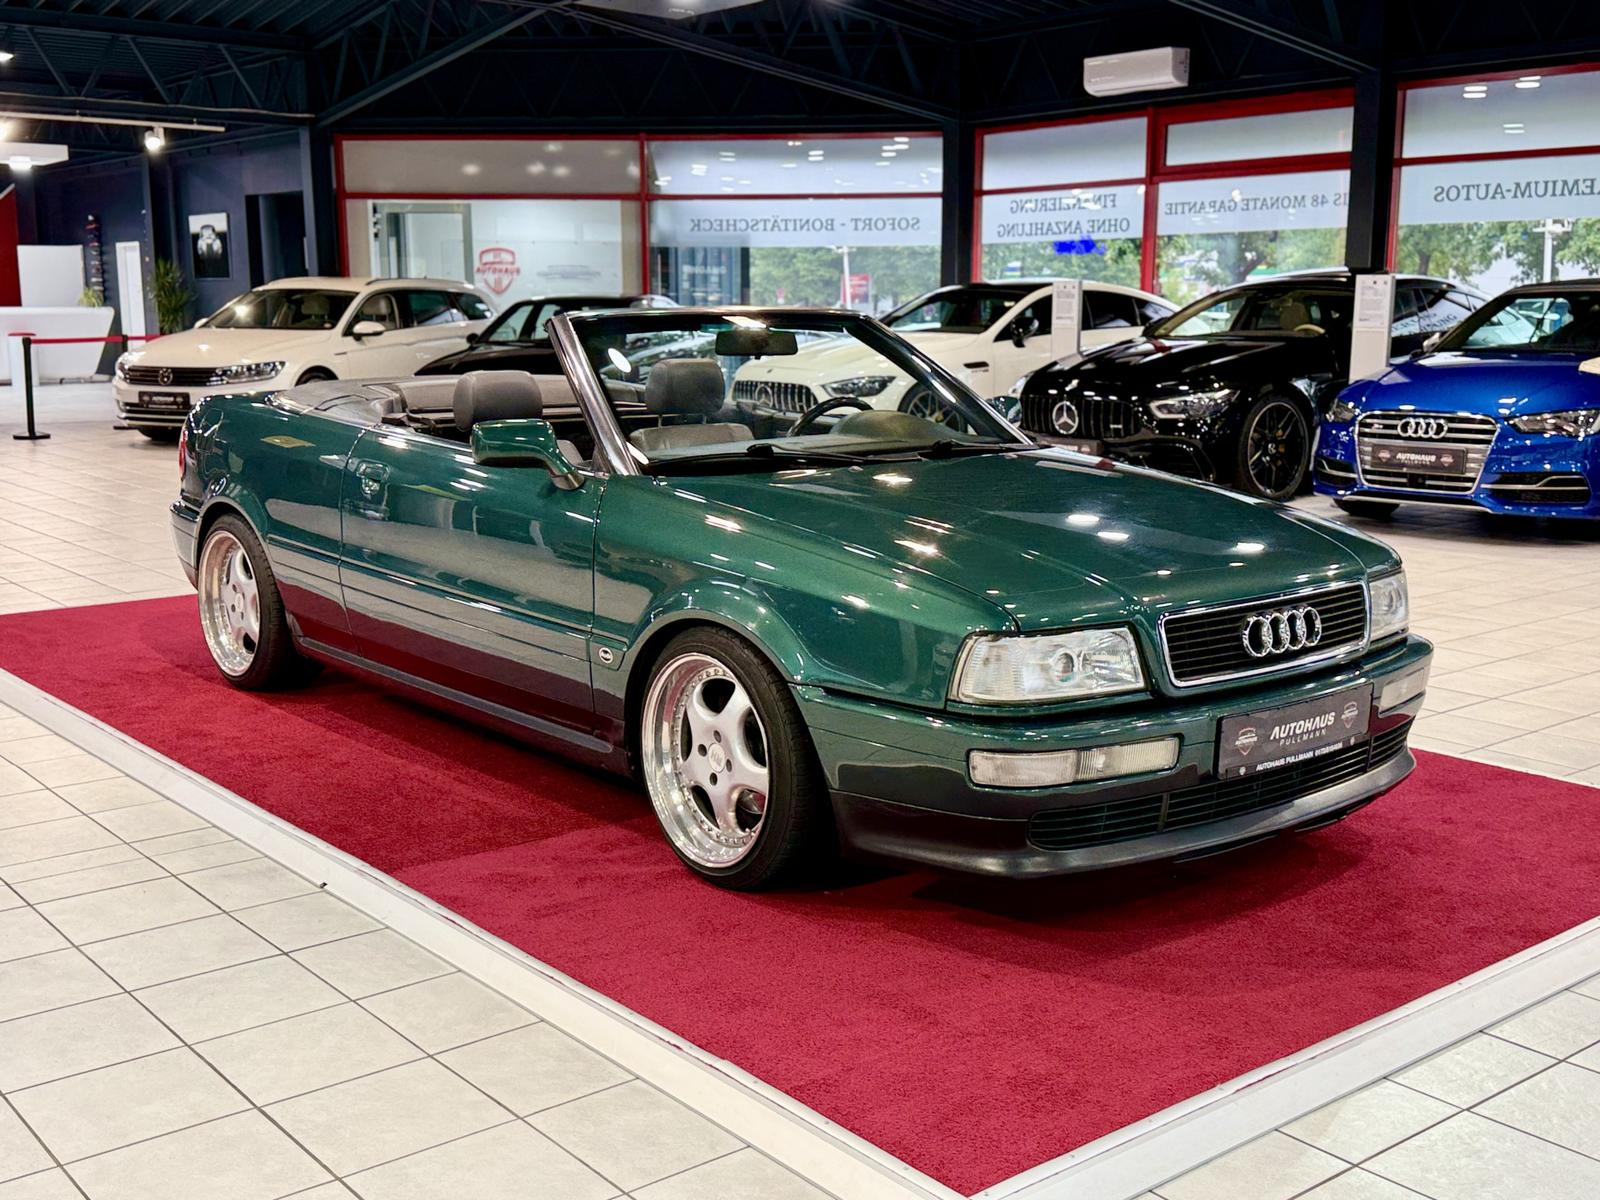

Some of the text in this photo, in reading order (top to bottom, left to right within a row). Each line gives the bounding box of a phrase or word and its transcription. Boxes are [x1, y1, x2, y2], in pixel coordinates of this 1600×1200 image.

[474, 267, 521, 276] AUTOHAUS
[1396, 452, 1437, 462] AUTOHAUS
[1270, 712, 1336, 740] AUTOHAUS
[1280, 729, 1327, 746] PULLMANN
[1256, 751, 1314, 771] AUTOHAUS PULLMANN
